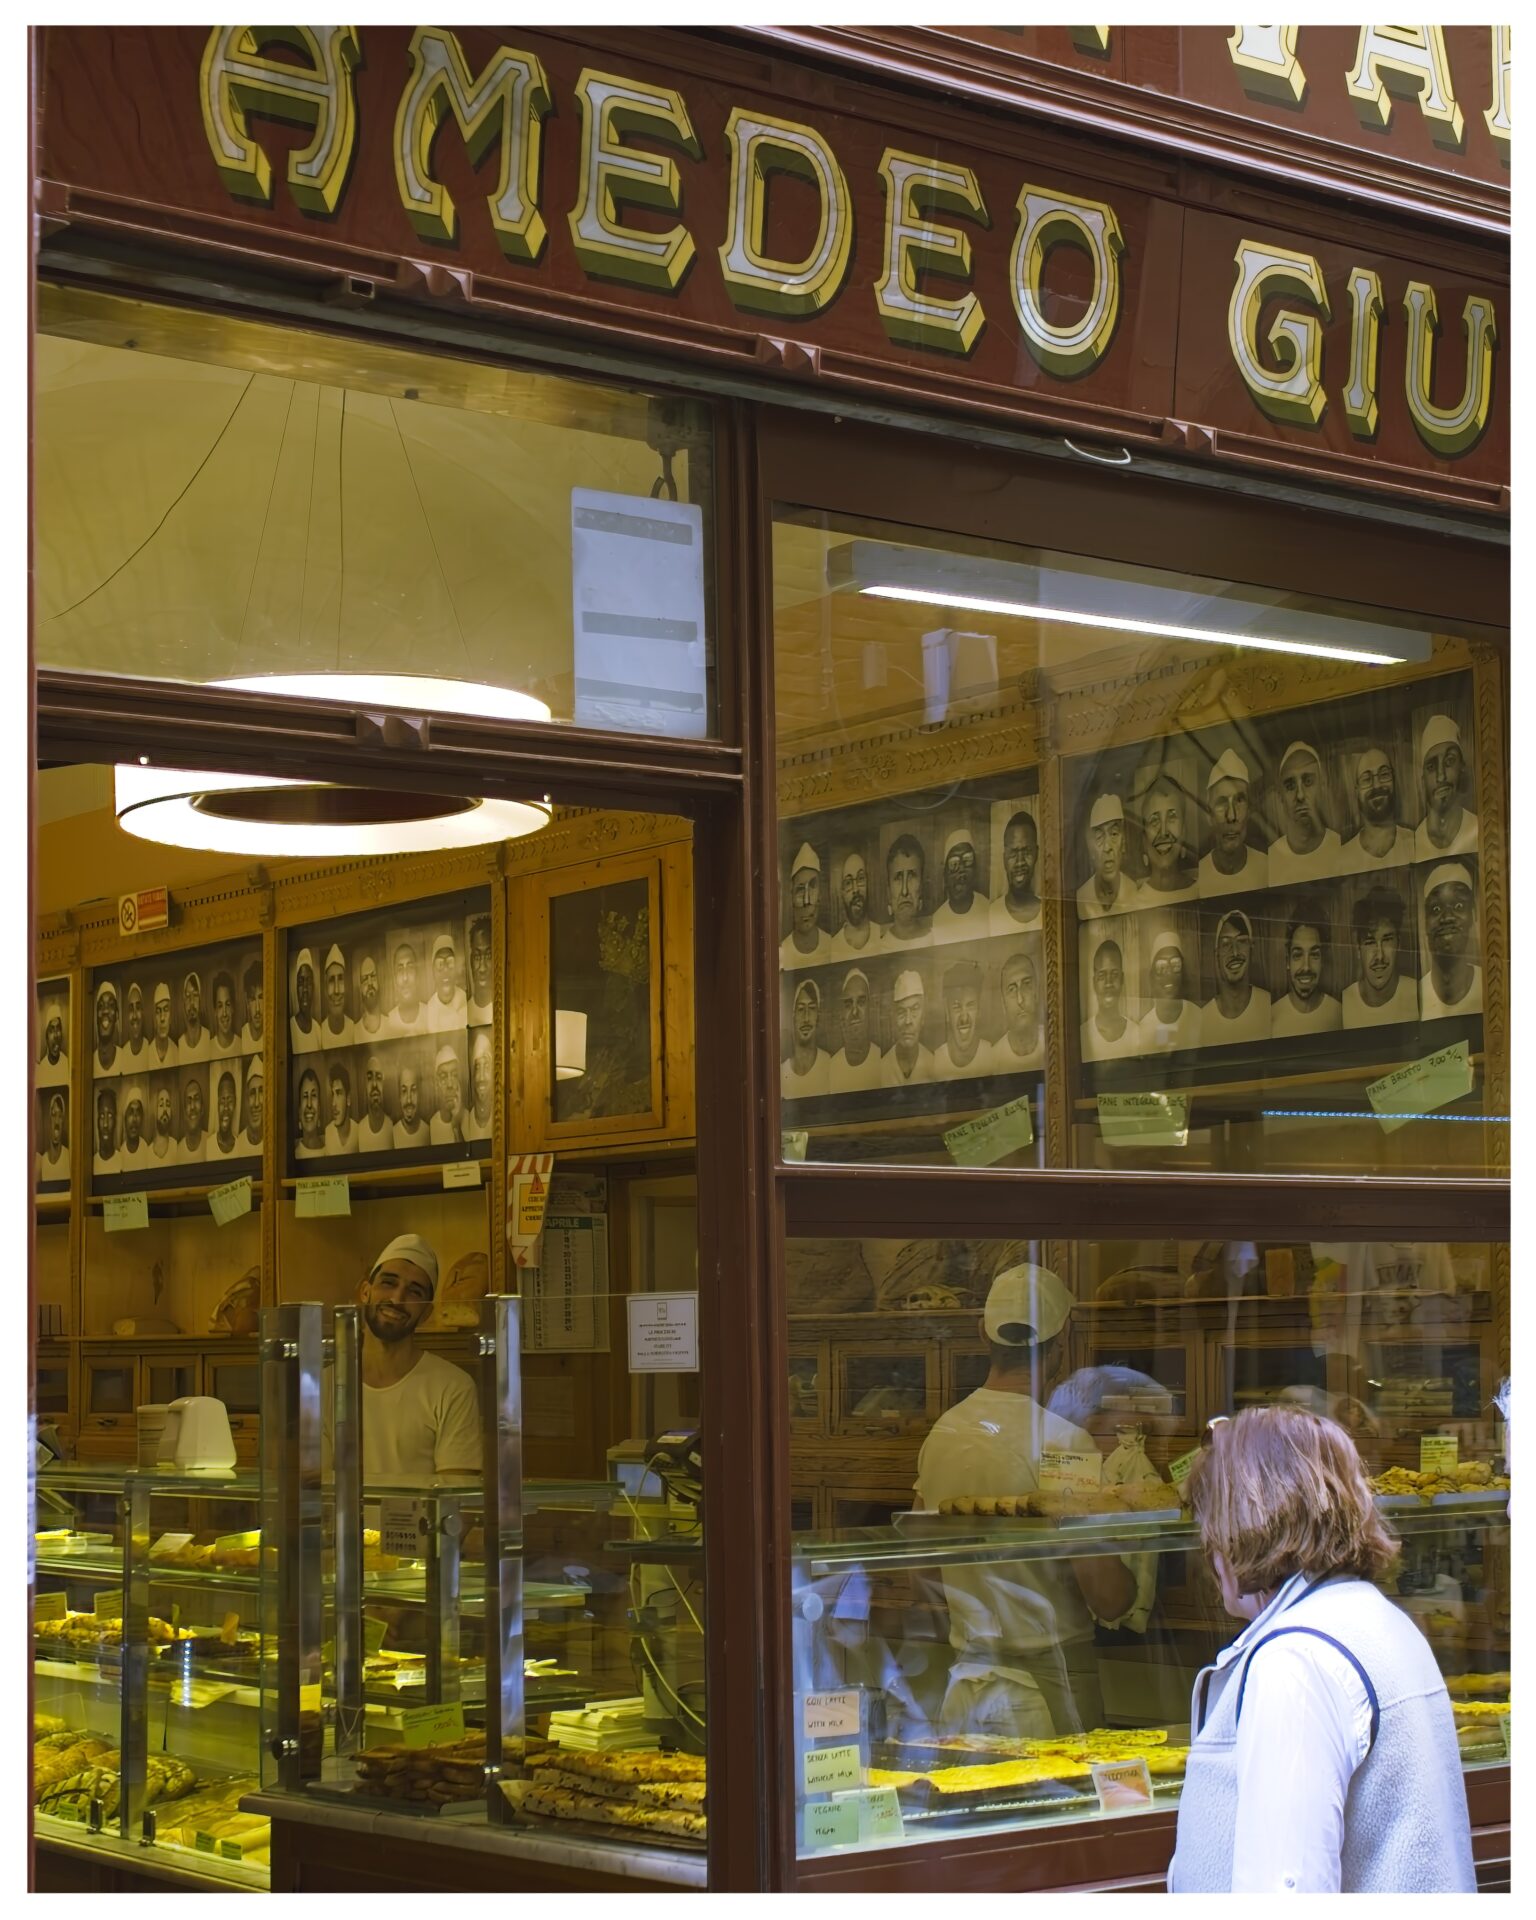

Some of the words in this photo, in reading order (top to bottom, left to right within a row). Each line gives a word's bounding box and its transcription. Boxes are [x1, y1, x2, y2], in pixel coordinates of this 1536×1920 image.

[199, 26, 1125, 378] AMEDEO
[1227, 238, 1496, 448] GIU
[1368, 1080, 1387, 1097] PANE
[1390, 1063, 1422, 1085] BRUTTO
[1098, 1096, 1118, 1106] PANE
[946, 1127, 969, 1142] PANE
